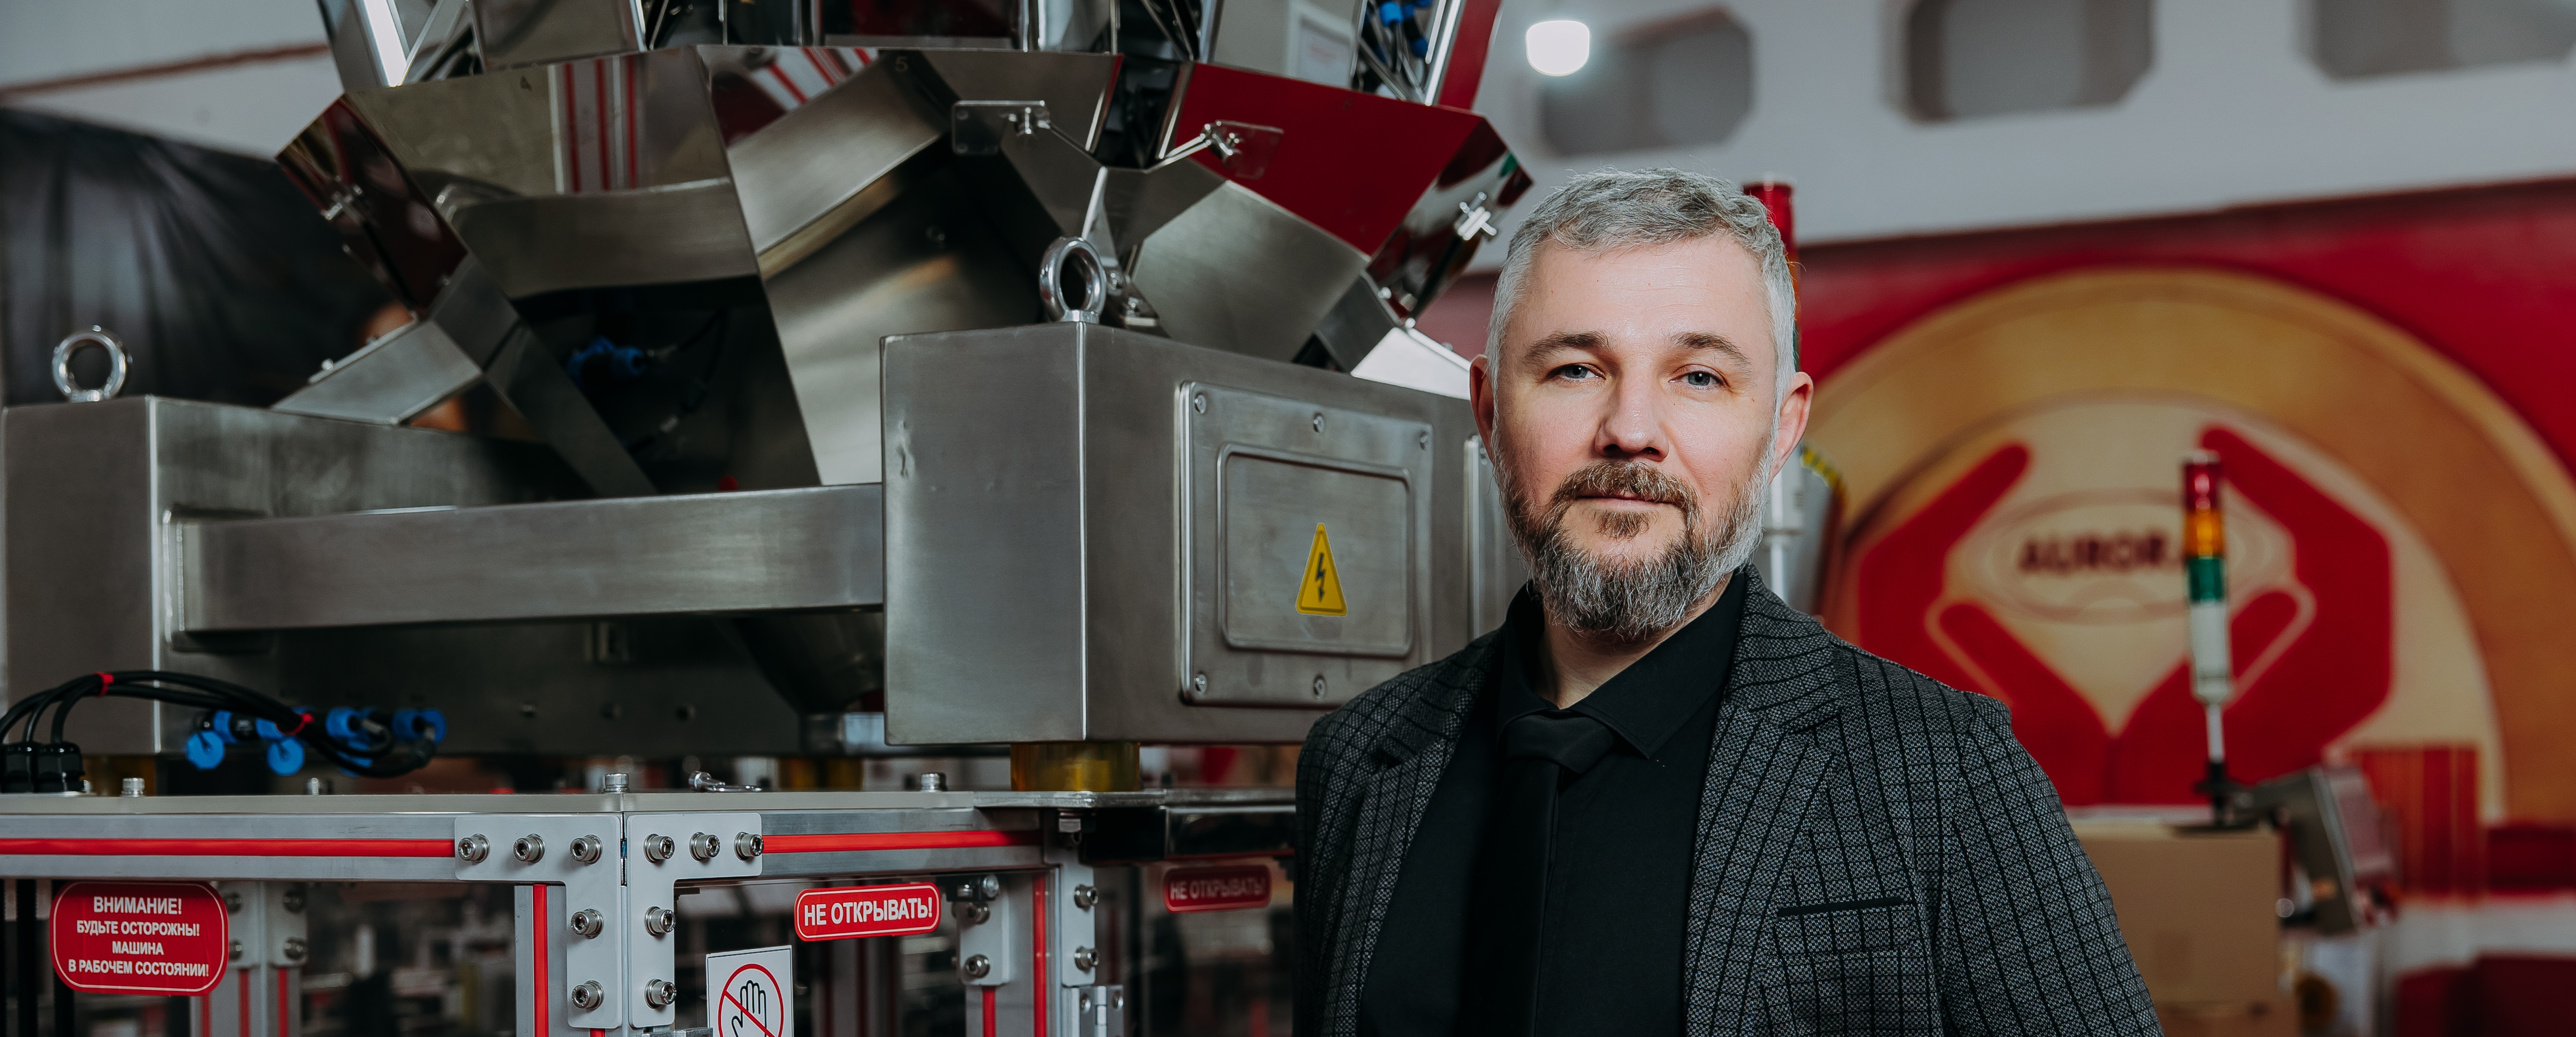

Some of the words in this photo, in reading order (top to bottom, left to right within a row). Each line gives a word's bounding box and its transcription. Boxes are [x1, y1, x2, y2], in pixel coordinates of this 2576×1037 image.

[896, 56, 909, 72] 5
[2018, 529, 2185, 574] AUROR
[1170, 880, 1188, 900] НЕ
[93, 896, 182, 914] ВНИМАНИЕ!
[804, 904, 827, 926] НЕ
[831, 897, 933, 924] ОТКРЫВАТЬ!
[77, 919, 118, 936] БУДЬТЕ
[121, 921, 200, 936] ОСТОРОЖНЫ!
[112, 941, 164, 955] МАШИНА
[68, 959, 76, 972] В
[79, 959, 132, 974] РАБОЧЕМ
[135, 961, 209, 977] СОСТОЯНИИ!
